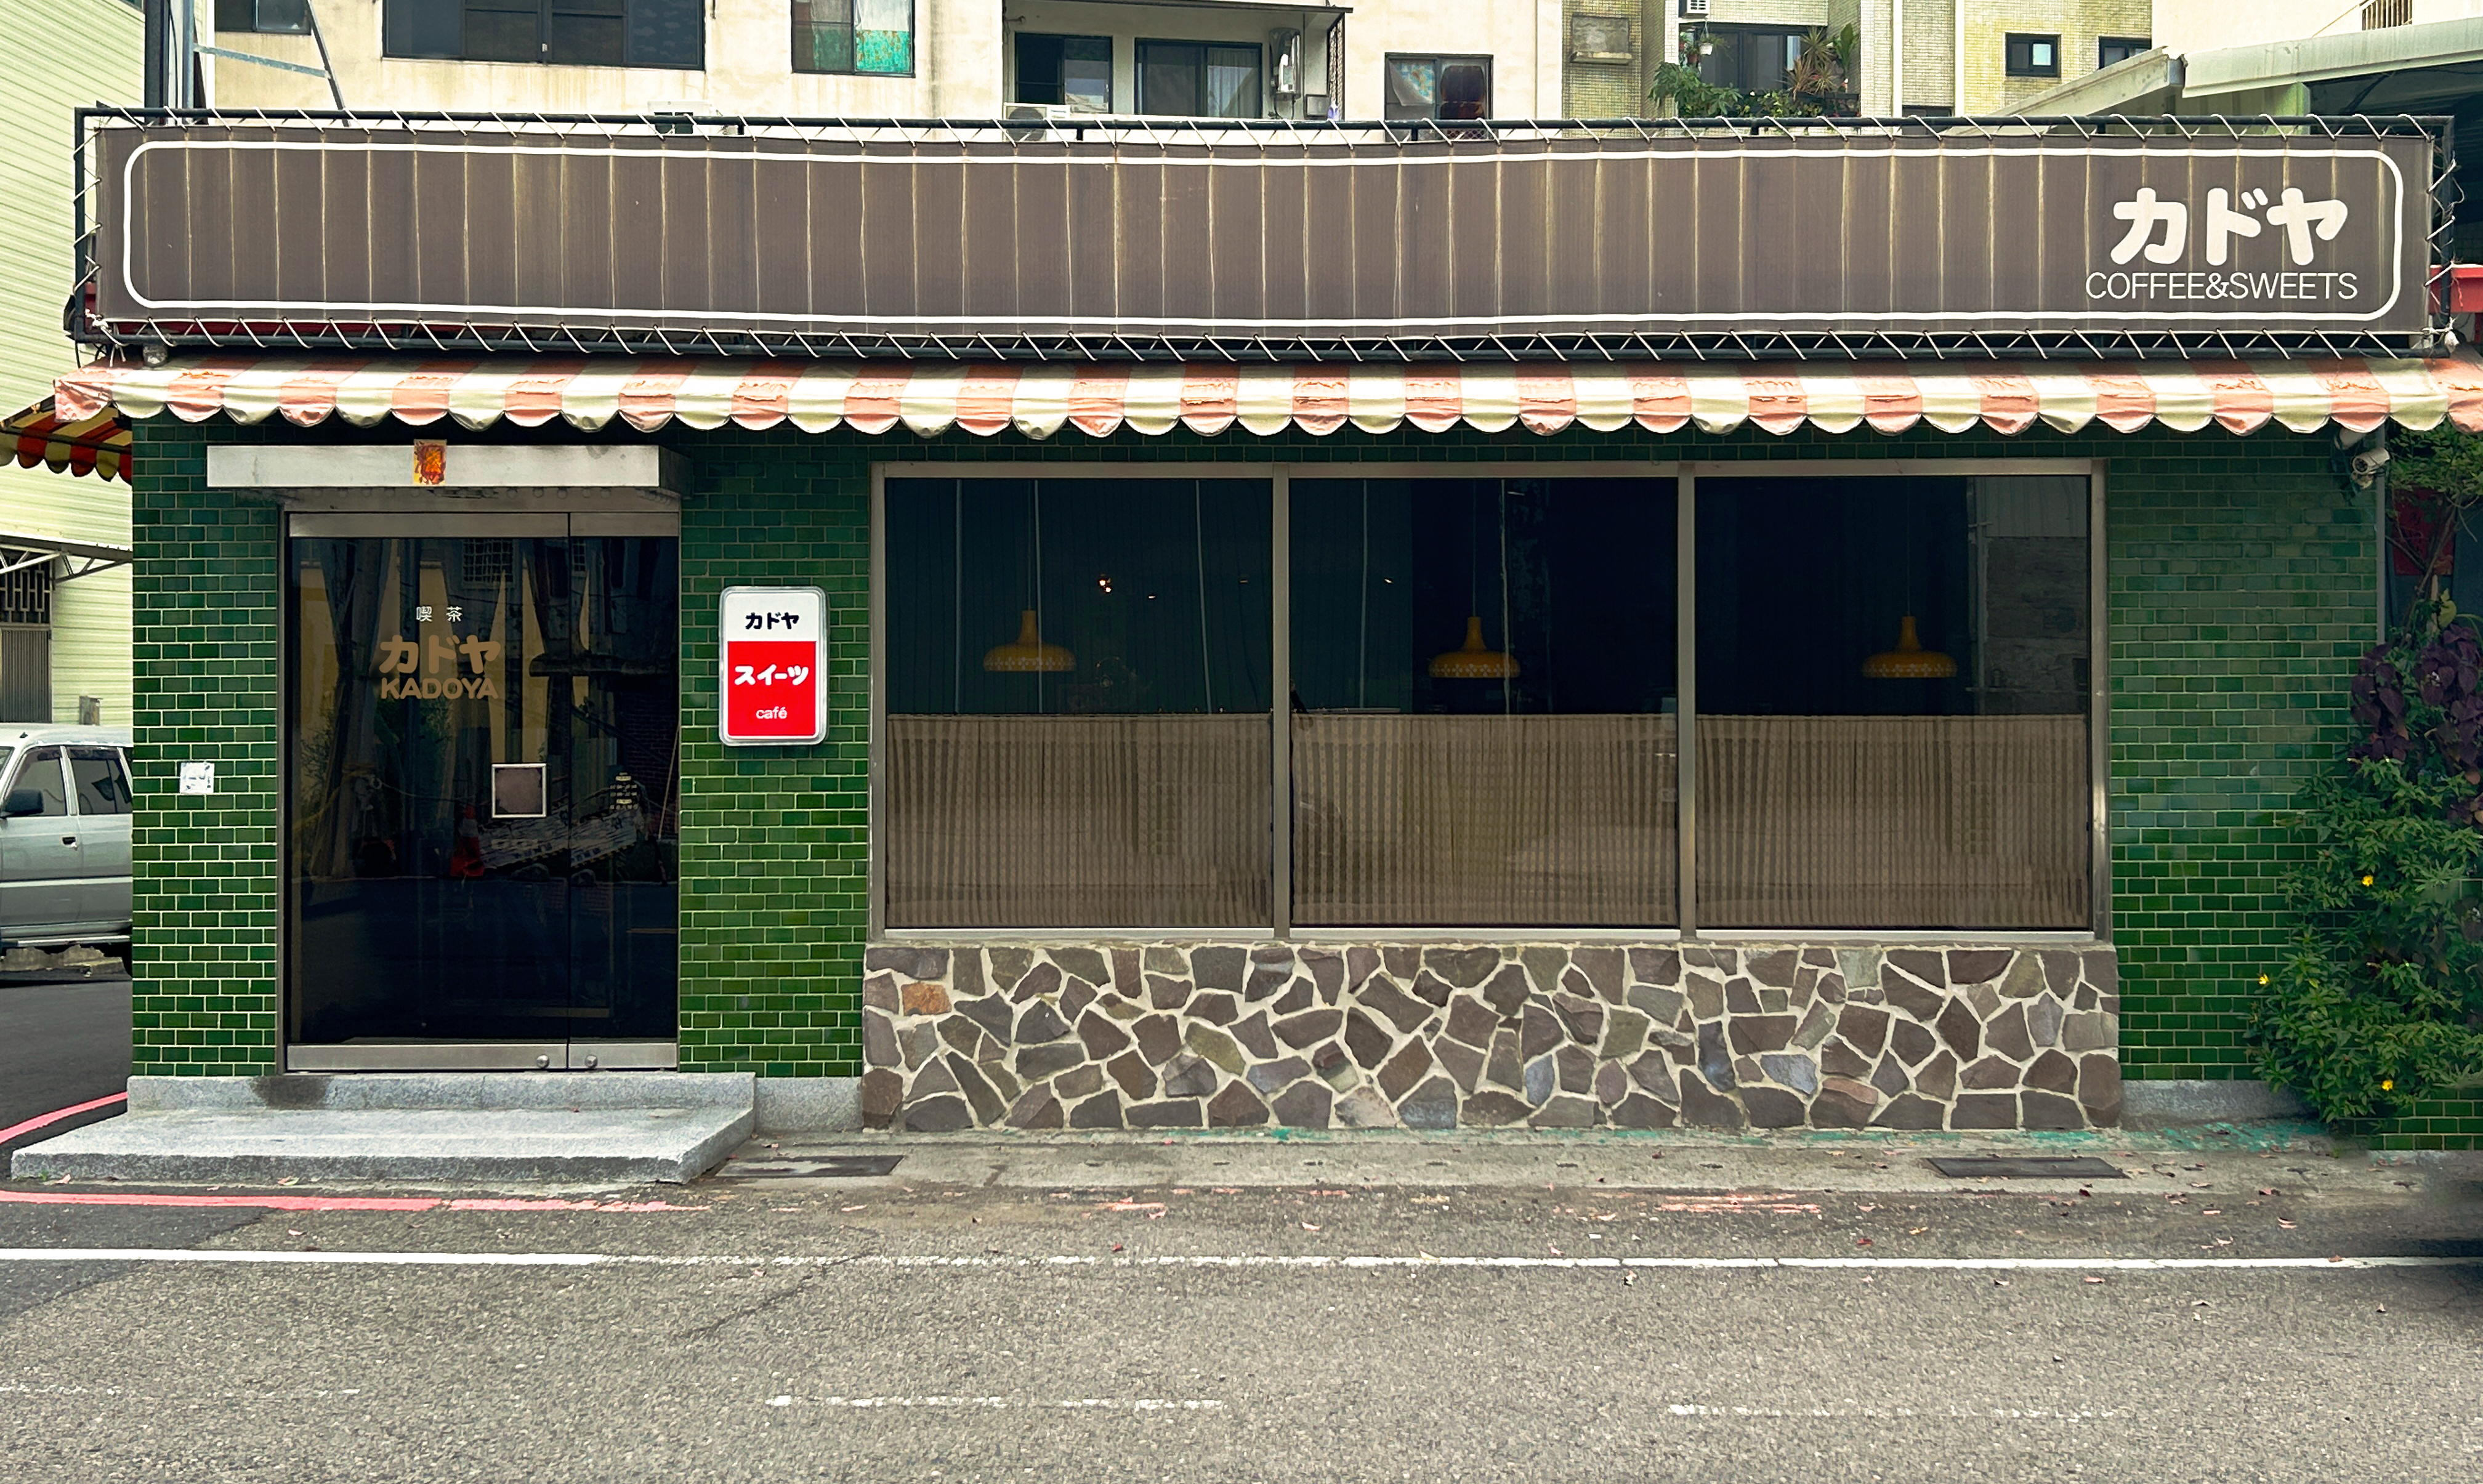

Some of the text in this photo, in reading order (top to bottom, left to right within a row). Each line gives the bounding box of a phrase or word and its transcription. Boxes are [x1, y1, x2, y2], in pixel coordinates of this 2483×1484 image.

[2110, 187, 2348, 265] カドヤ
[2086, 272, 2357, 299] COFFEE&SWEETS
[745, 612, 799, 630] カドヤ
[379, 635, 501, 674] カドヤ
[734, 664, 809, 686] スイーツ
[381, 677, 498, 699] KADOYA
[756, 706, 788, 719] café
